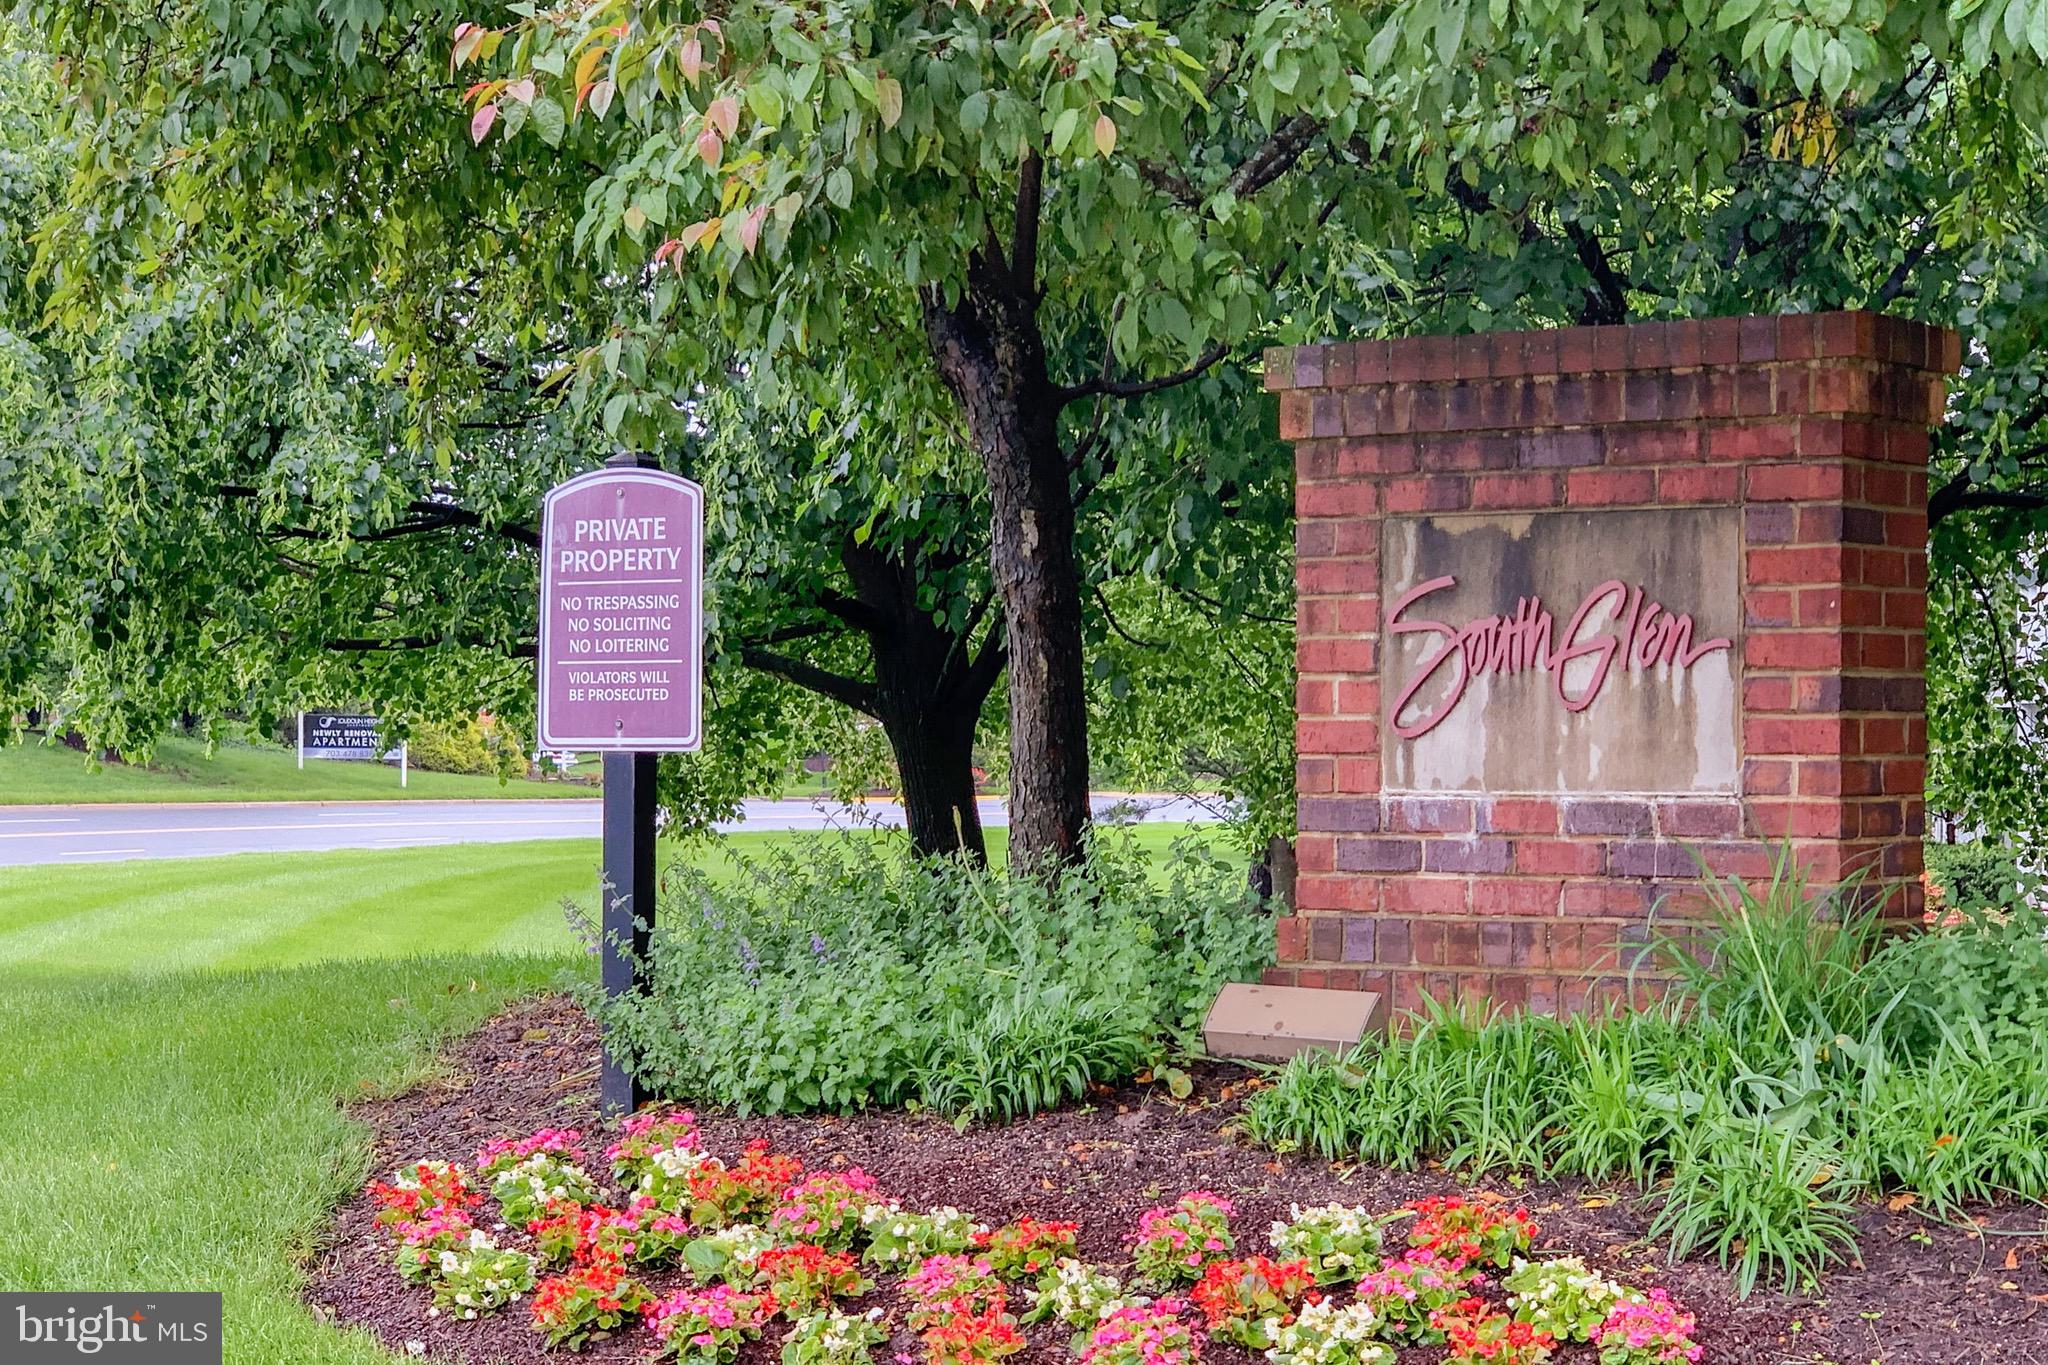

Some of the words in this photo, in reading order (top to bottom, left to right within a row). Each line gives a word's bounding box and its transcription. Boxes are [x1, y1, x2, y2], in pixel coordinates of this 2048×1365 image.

[574, 517, 666, 542] PRIVATE
[560, 547, 682, 573] PROPERTY
[560, 597, 582, 611] NO
[585, 594, 680, 611] TRESPASSING
[568, 618, 589, 632] NO
[593, 616, 671, 632] SOLICITING
[569, 639, 591, 653] NO
[595, 638, 669, 653] LOITERING
[1386, 575, 1553, 739] South
[1551, 579, 1732, 712] Glen
[568, 672, 637, 684] VIOLATORS
[640, 671, 670, 684] WILL
[569, 689, 584, 701] BE
[588, 688, 669, 701] PROSECUTED
[312, 729, 341, 737] NEWLY
[344, 729, 383, 737] RENOVA
